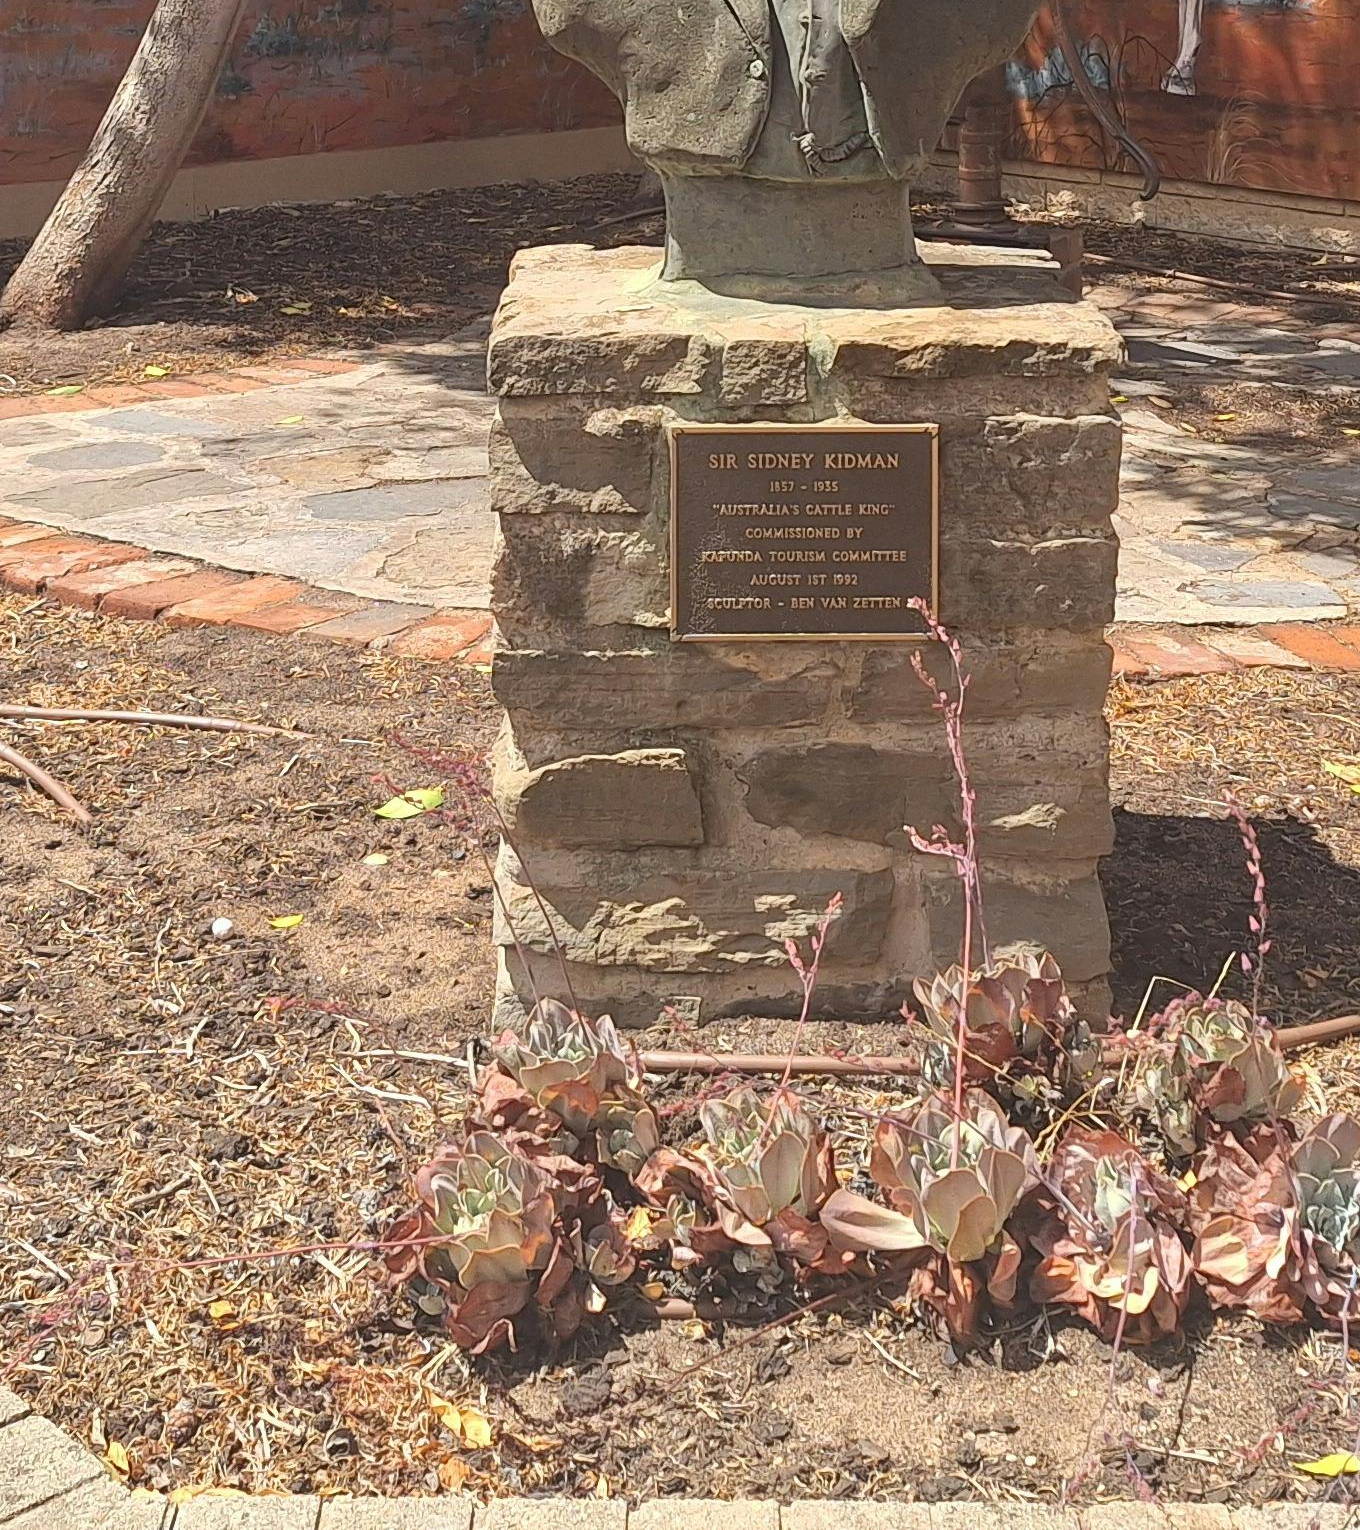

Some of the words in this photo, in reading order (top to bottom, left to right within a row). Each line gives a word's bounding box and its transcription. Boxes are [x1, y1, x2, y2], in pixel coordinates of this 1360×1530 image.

[708, 453, 738, 469] SIR
[747, 453, 815, 469] SIDNEY
[824, 453, 900, 469] KIDMAN
[769, 480, 795, 493] 1857
[813, 480, 839, 493] 1935
[712, 503, 800, 516] "AUSTRALIA'S
[805, 503, 853, 516] CATTLE
[858, 503, 896, 516] KING"
[745, 527, 840, 540] COMMISSIONED
[846, 527, 863, 540] BY
[701, 550, 763, 562] KAPUNDA
[769, 550, 826, 562] TOURISM
[832, 550, 907, 562] COMMITTEE
[750, 574, 801, 586] AUGUST
[807, 574, 827, 586] 1ST
[833, 574, 858, 586] 1992
[706, 597, 772, 610] SCULPTOR
[790, 597, 815, 610] BEN
[820, 597, 847, 610] VAN
[852, 597, 901, 610] ZETTEN
